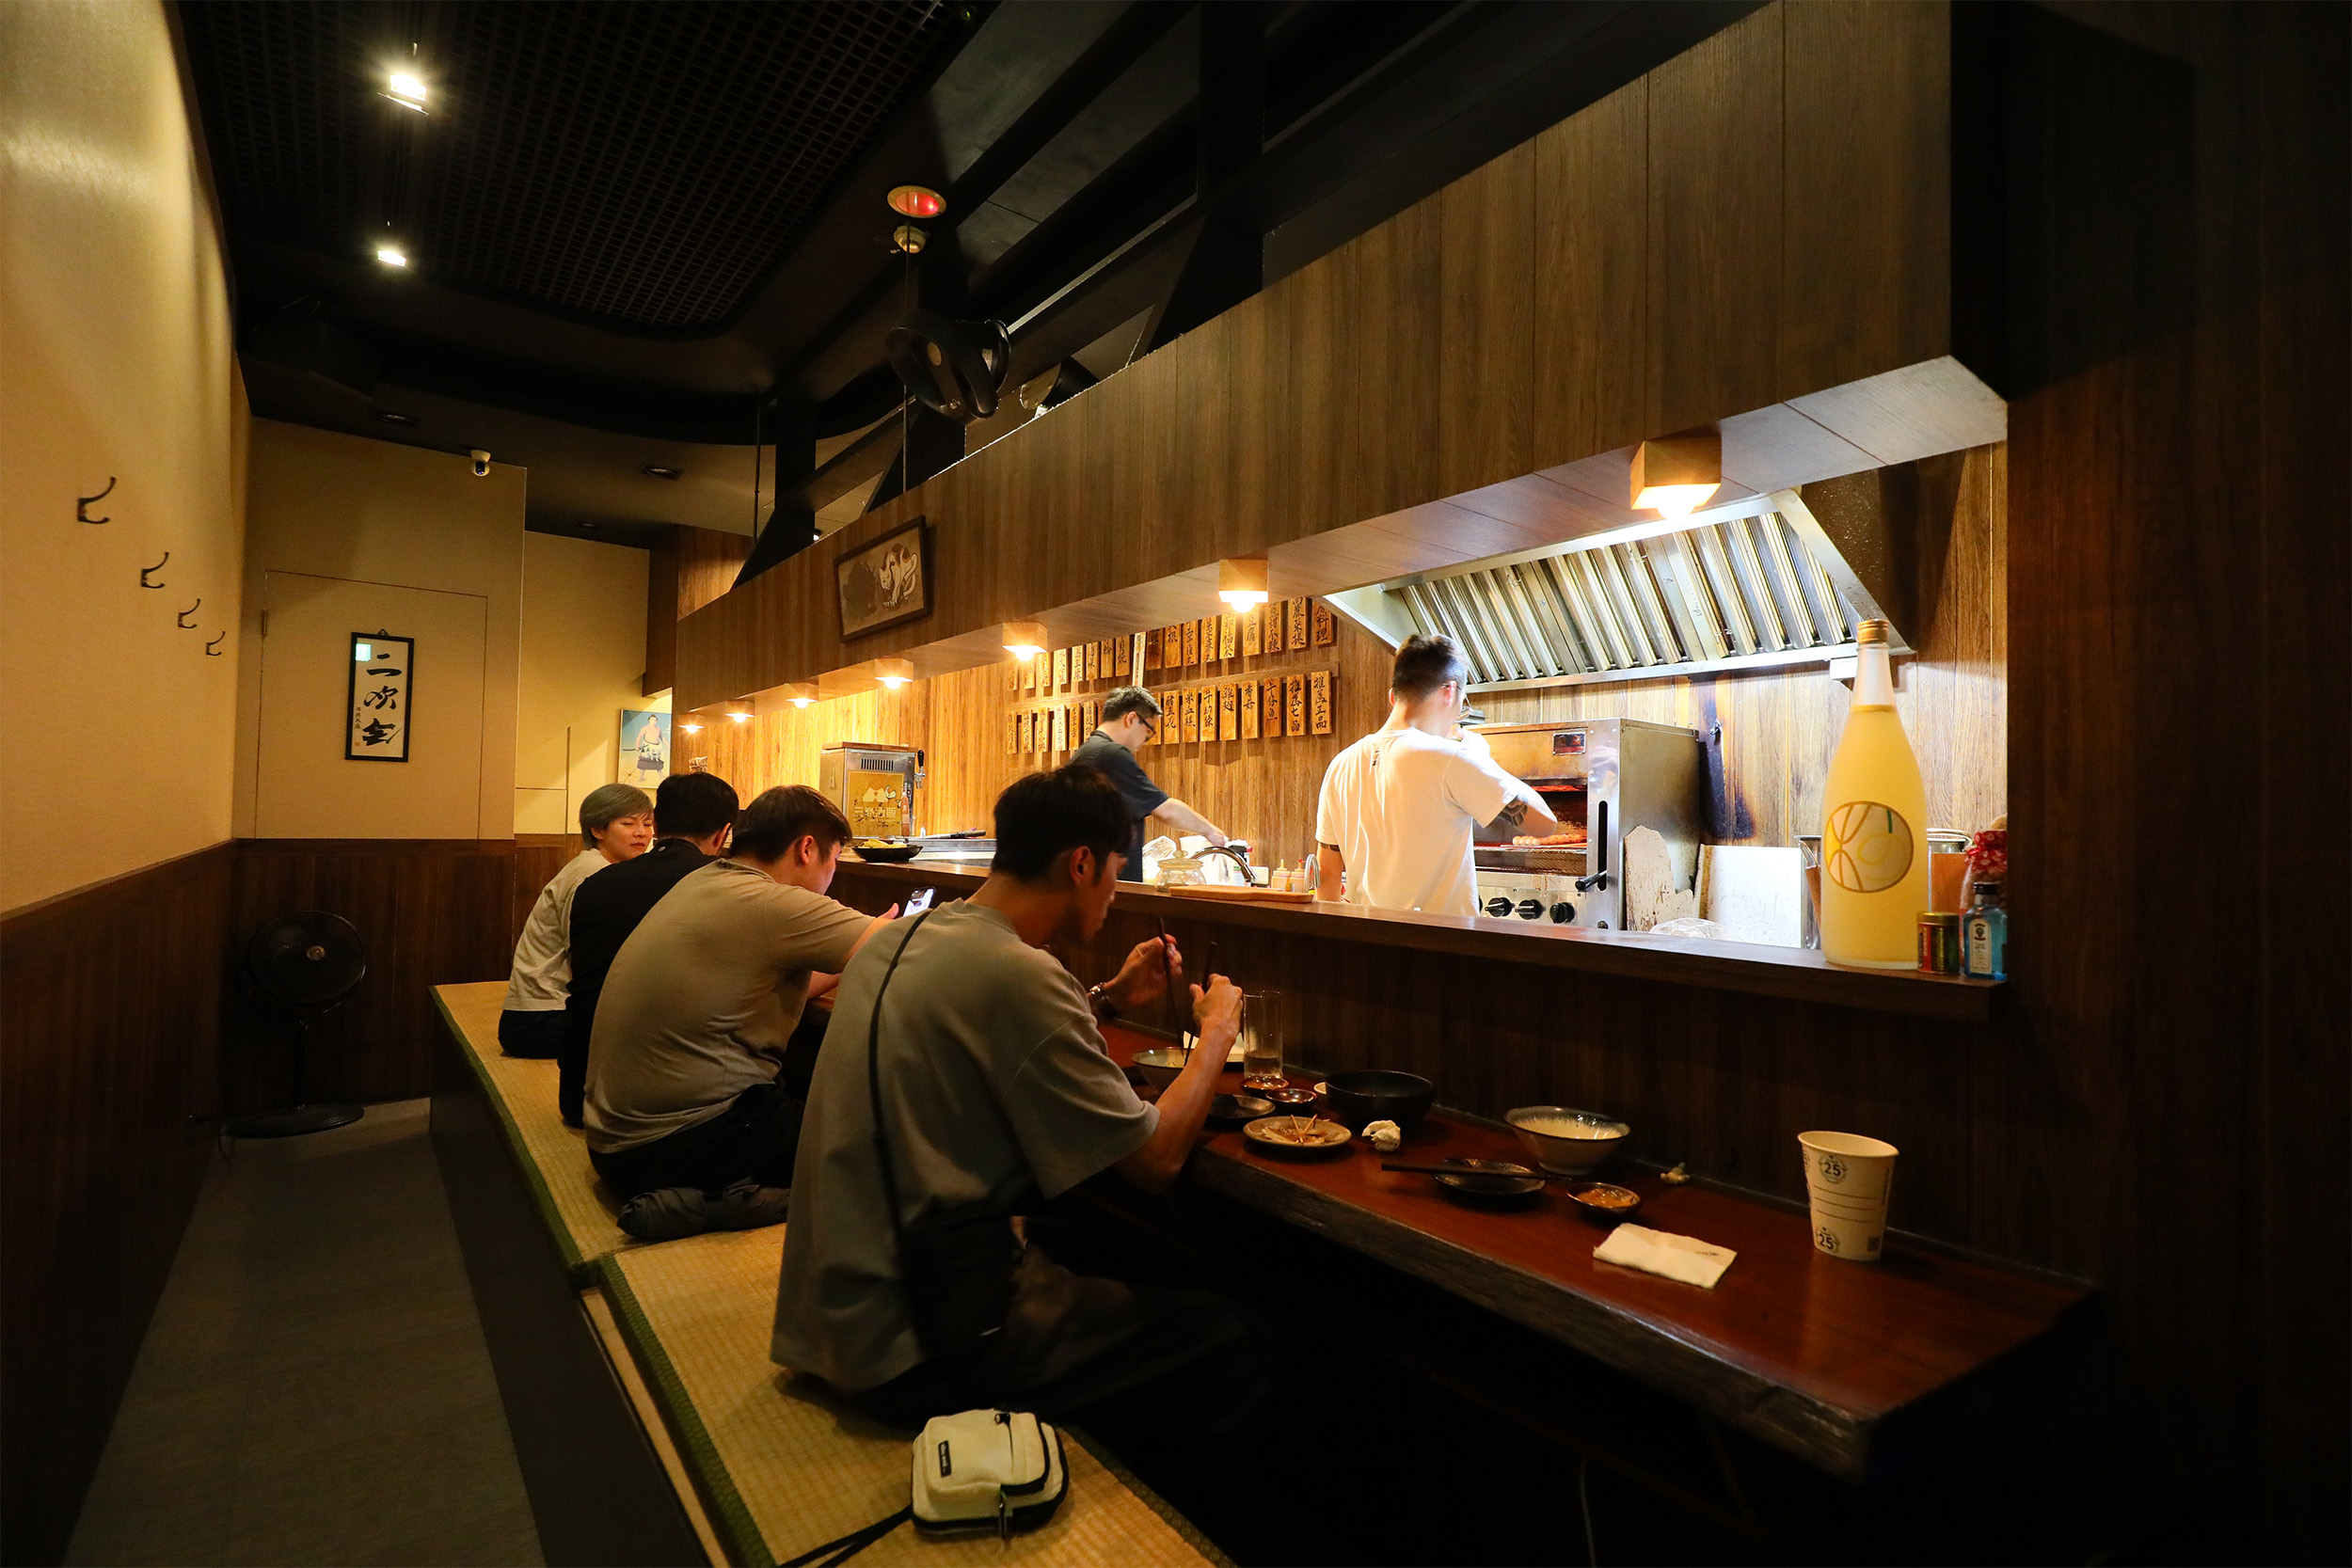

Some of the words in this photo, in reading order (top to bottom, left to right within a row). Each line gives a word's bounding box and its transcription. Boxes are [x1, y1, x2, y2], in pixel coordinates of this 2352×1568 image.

[1184, 692, 1196, 727] 米血糕
[1221, 687, 1234, 712] 雞翅
[1243, 684, 1256, 710] 香菇
[1289, 678, 1303, 733] 推薦七品
[1312, 674, 1327, 730] 推薦五品
[1823, 1162, 1842, 1178] 25
[1819, 1233, 1836, 1251] 25
